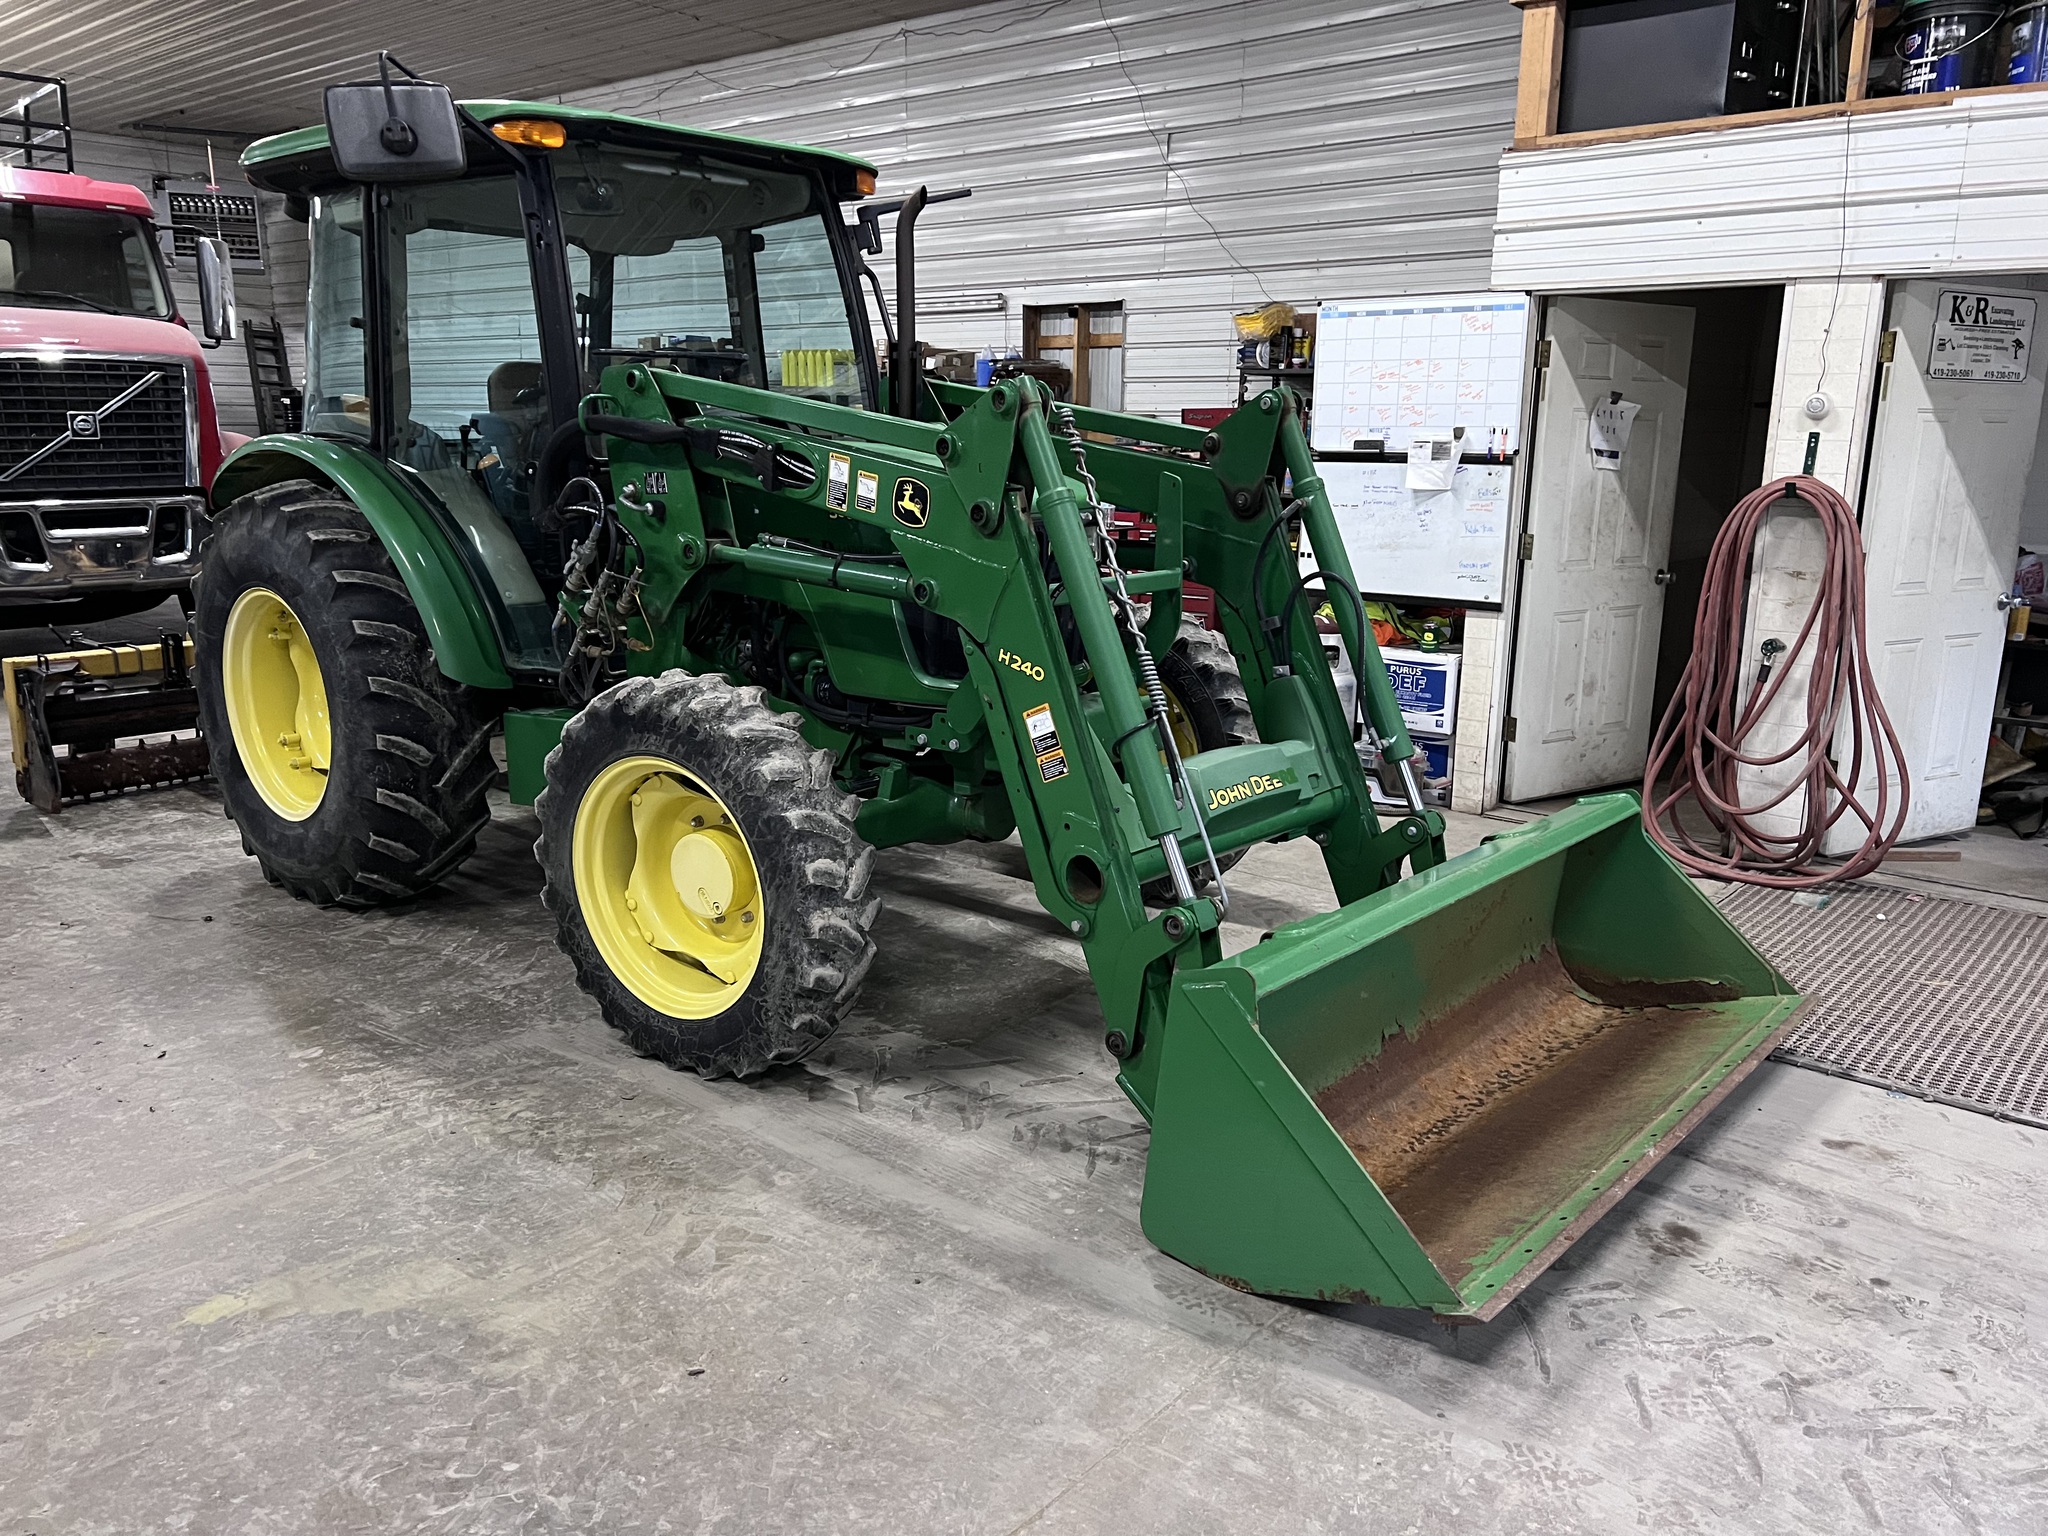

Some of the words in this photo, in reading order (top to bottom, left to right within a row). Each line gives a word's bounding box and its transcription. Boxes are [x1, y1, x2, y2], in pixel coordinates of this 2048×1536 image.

[1933, 368, 1973, 378] 419-230-5061
[1984, 370, 2020, 380] 419-230-5710
[998, 648, 1045, 682] H240
[1390, 665, 1422, 675] PURUS
[1387, 673, 1427, 692] DEF
[1208, 781, 1252, 811] JOHN
